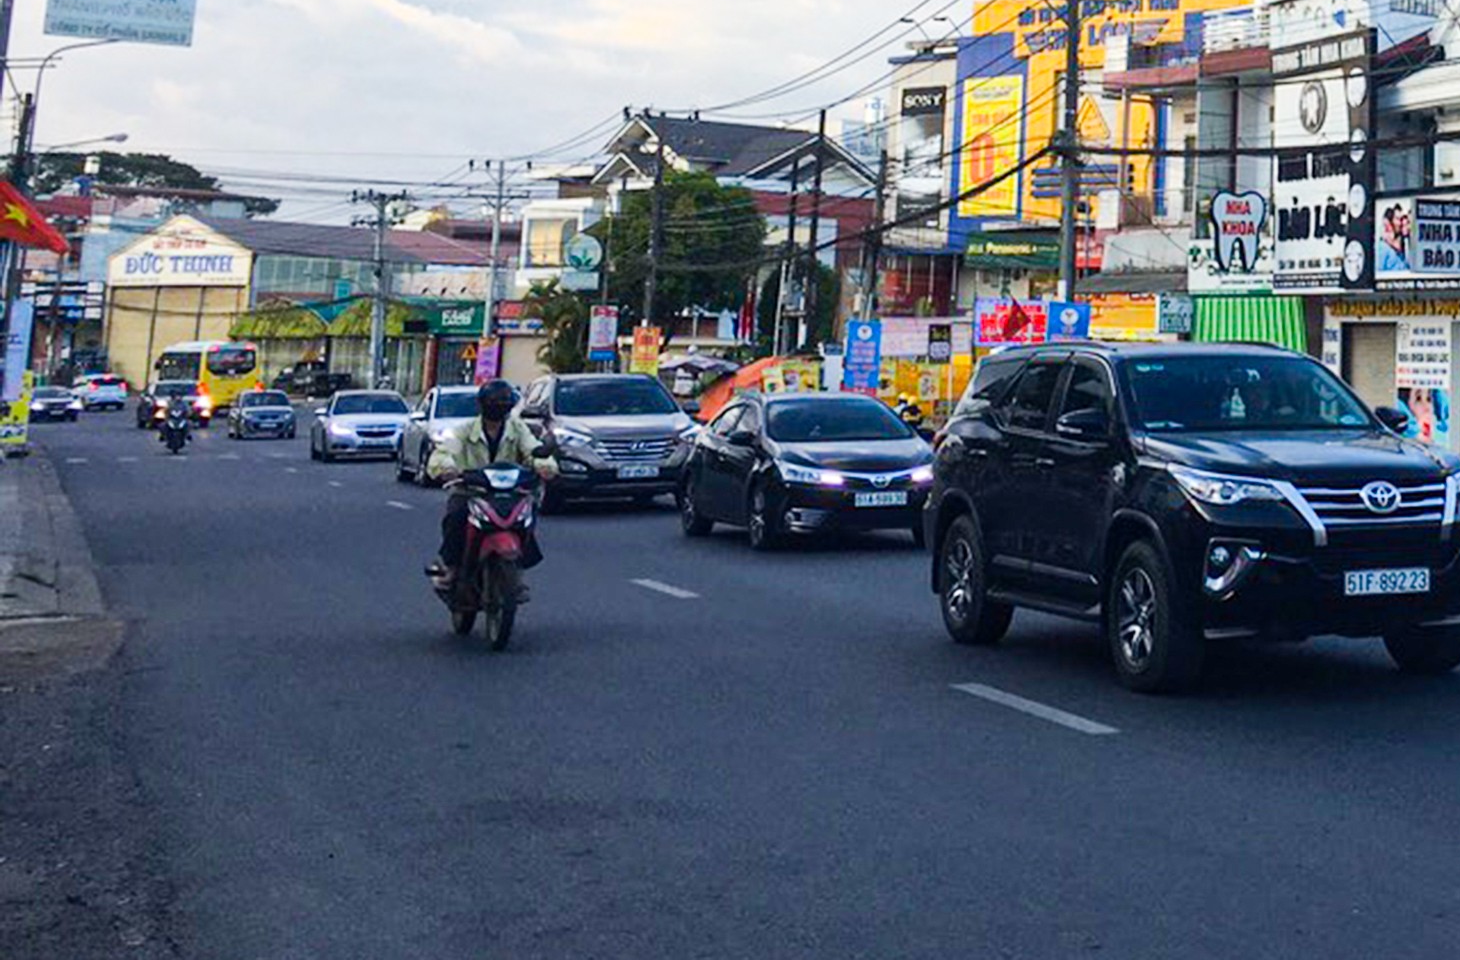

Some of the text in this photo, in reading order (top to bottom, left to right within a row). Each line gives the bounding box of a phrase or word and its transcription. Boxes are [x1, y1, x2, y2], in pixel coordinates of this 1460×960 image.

[903, 93, 943, 109] SONY
[1225, 200, 1252, 215] NHA
[1221, 220, 1256, 236] KHOA
[1419, 223, 1452, 243] NHA
[125, 251, 234, 277] ĐỨC THỊNH
[1422, 245, 1454, 268] BẢO
